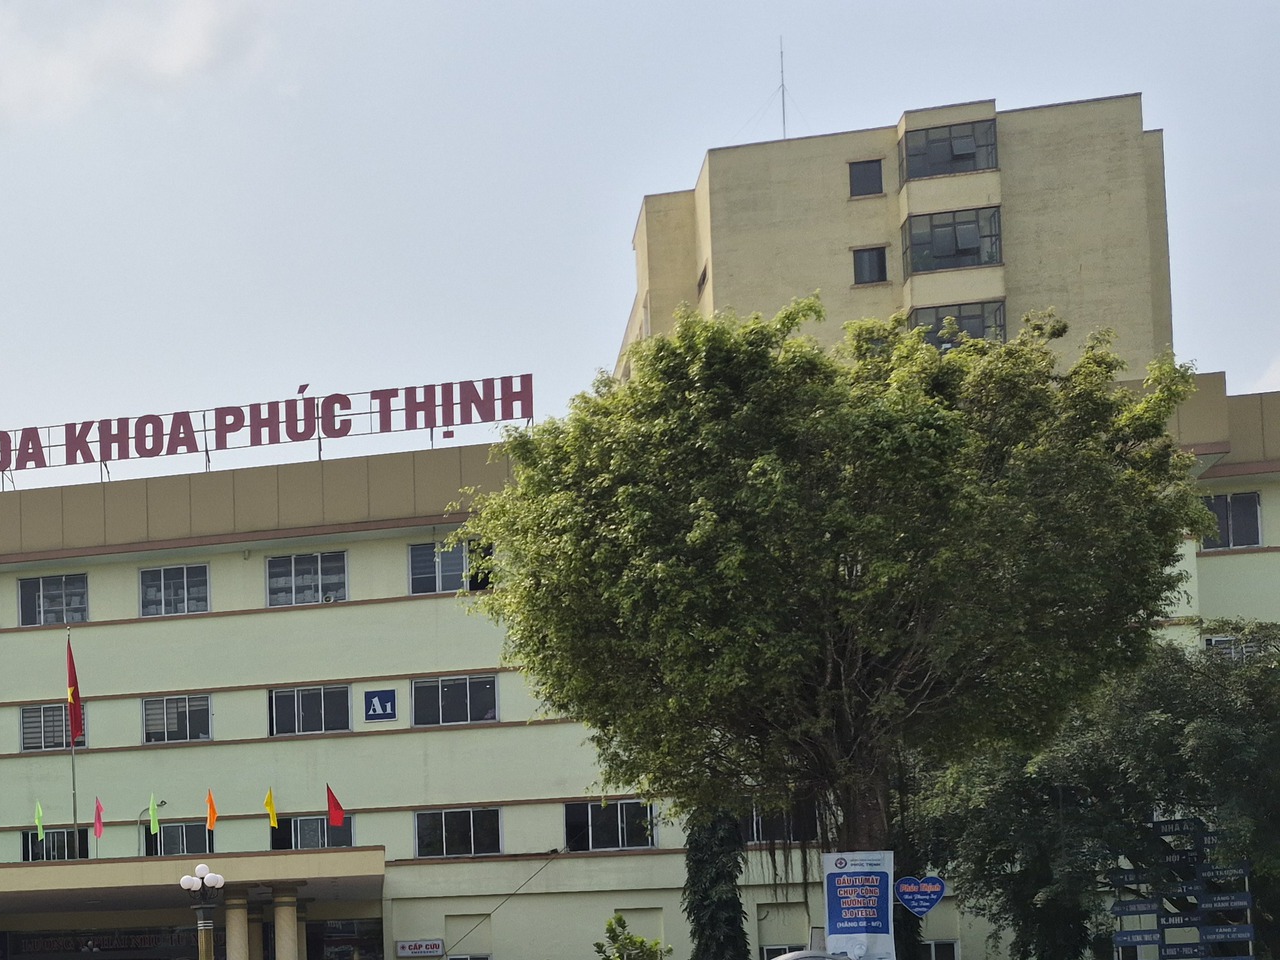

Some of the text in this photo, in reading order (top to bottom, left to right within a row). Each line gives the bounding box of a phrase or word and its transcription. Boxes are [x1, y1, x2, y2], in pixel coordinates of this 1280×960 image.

[64, 412, 199, 465] KHOA
[215, 384, 352, 449] PHÚC
[371, 373, 534, 439] THỊNH
[367, 696, 393, 715] A1
[836, 875, 852, 886] ĐẦU
[838, 887, 879, 898] CHỤP CỘNG
[900, 883, 919, 893] Phúc
[842, 909, 877, 919] 3.0 TESLA
[408, 942, 440, 951] CẤP CỨU
